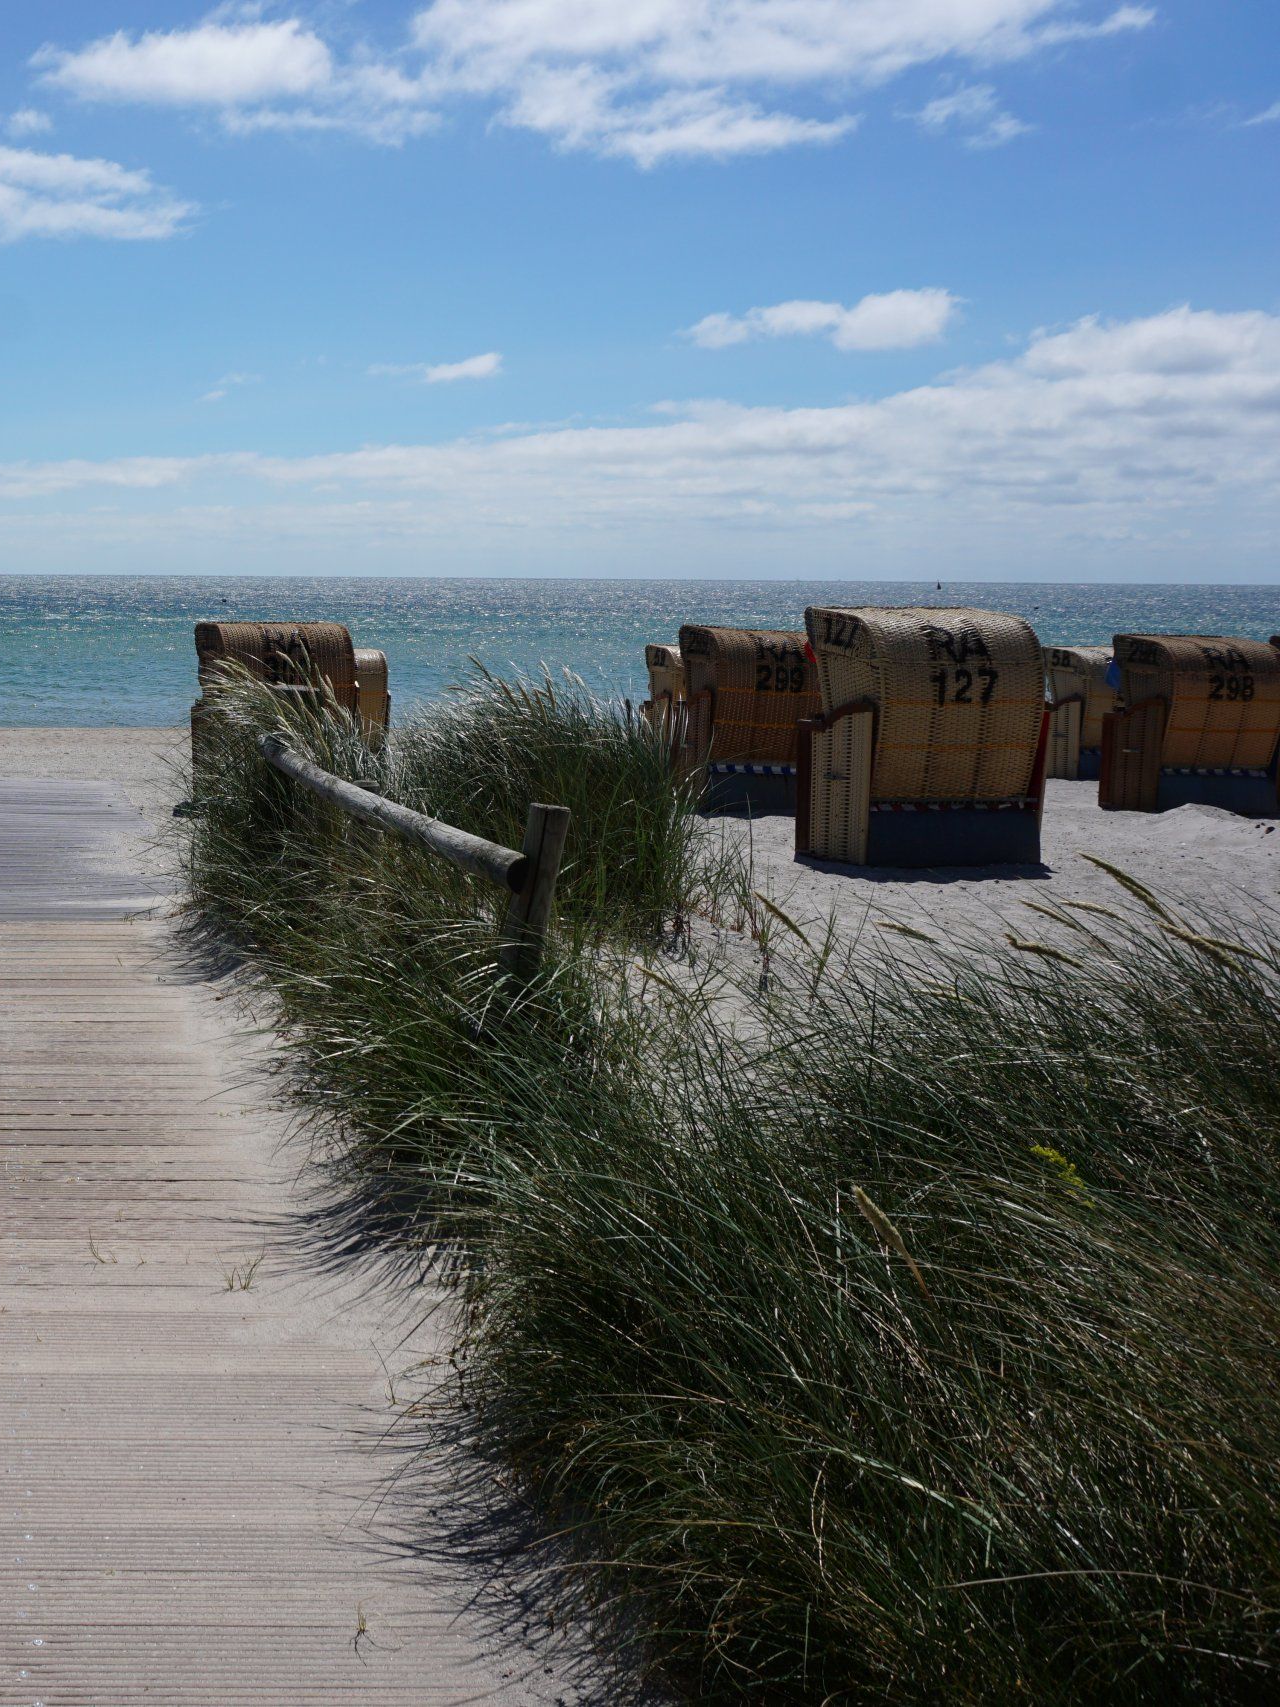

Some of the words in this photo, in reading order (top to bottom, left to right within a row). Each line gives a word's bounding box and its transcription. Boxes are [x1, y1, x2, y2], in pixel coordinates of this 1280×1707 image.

[922, 625, 991, 663] RA
[1202, 647, 1250, 671] RA
[930, 668, 999, 705] 127
[1208, 674, 1255, 701] 298
